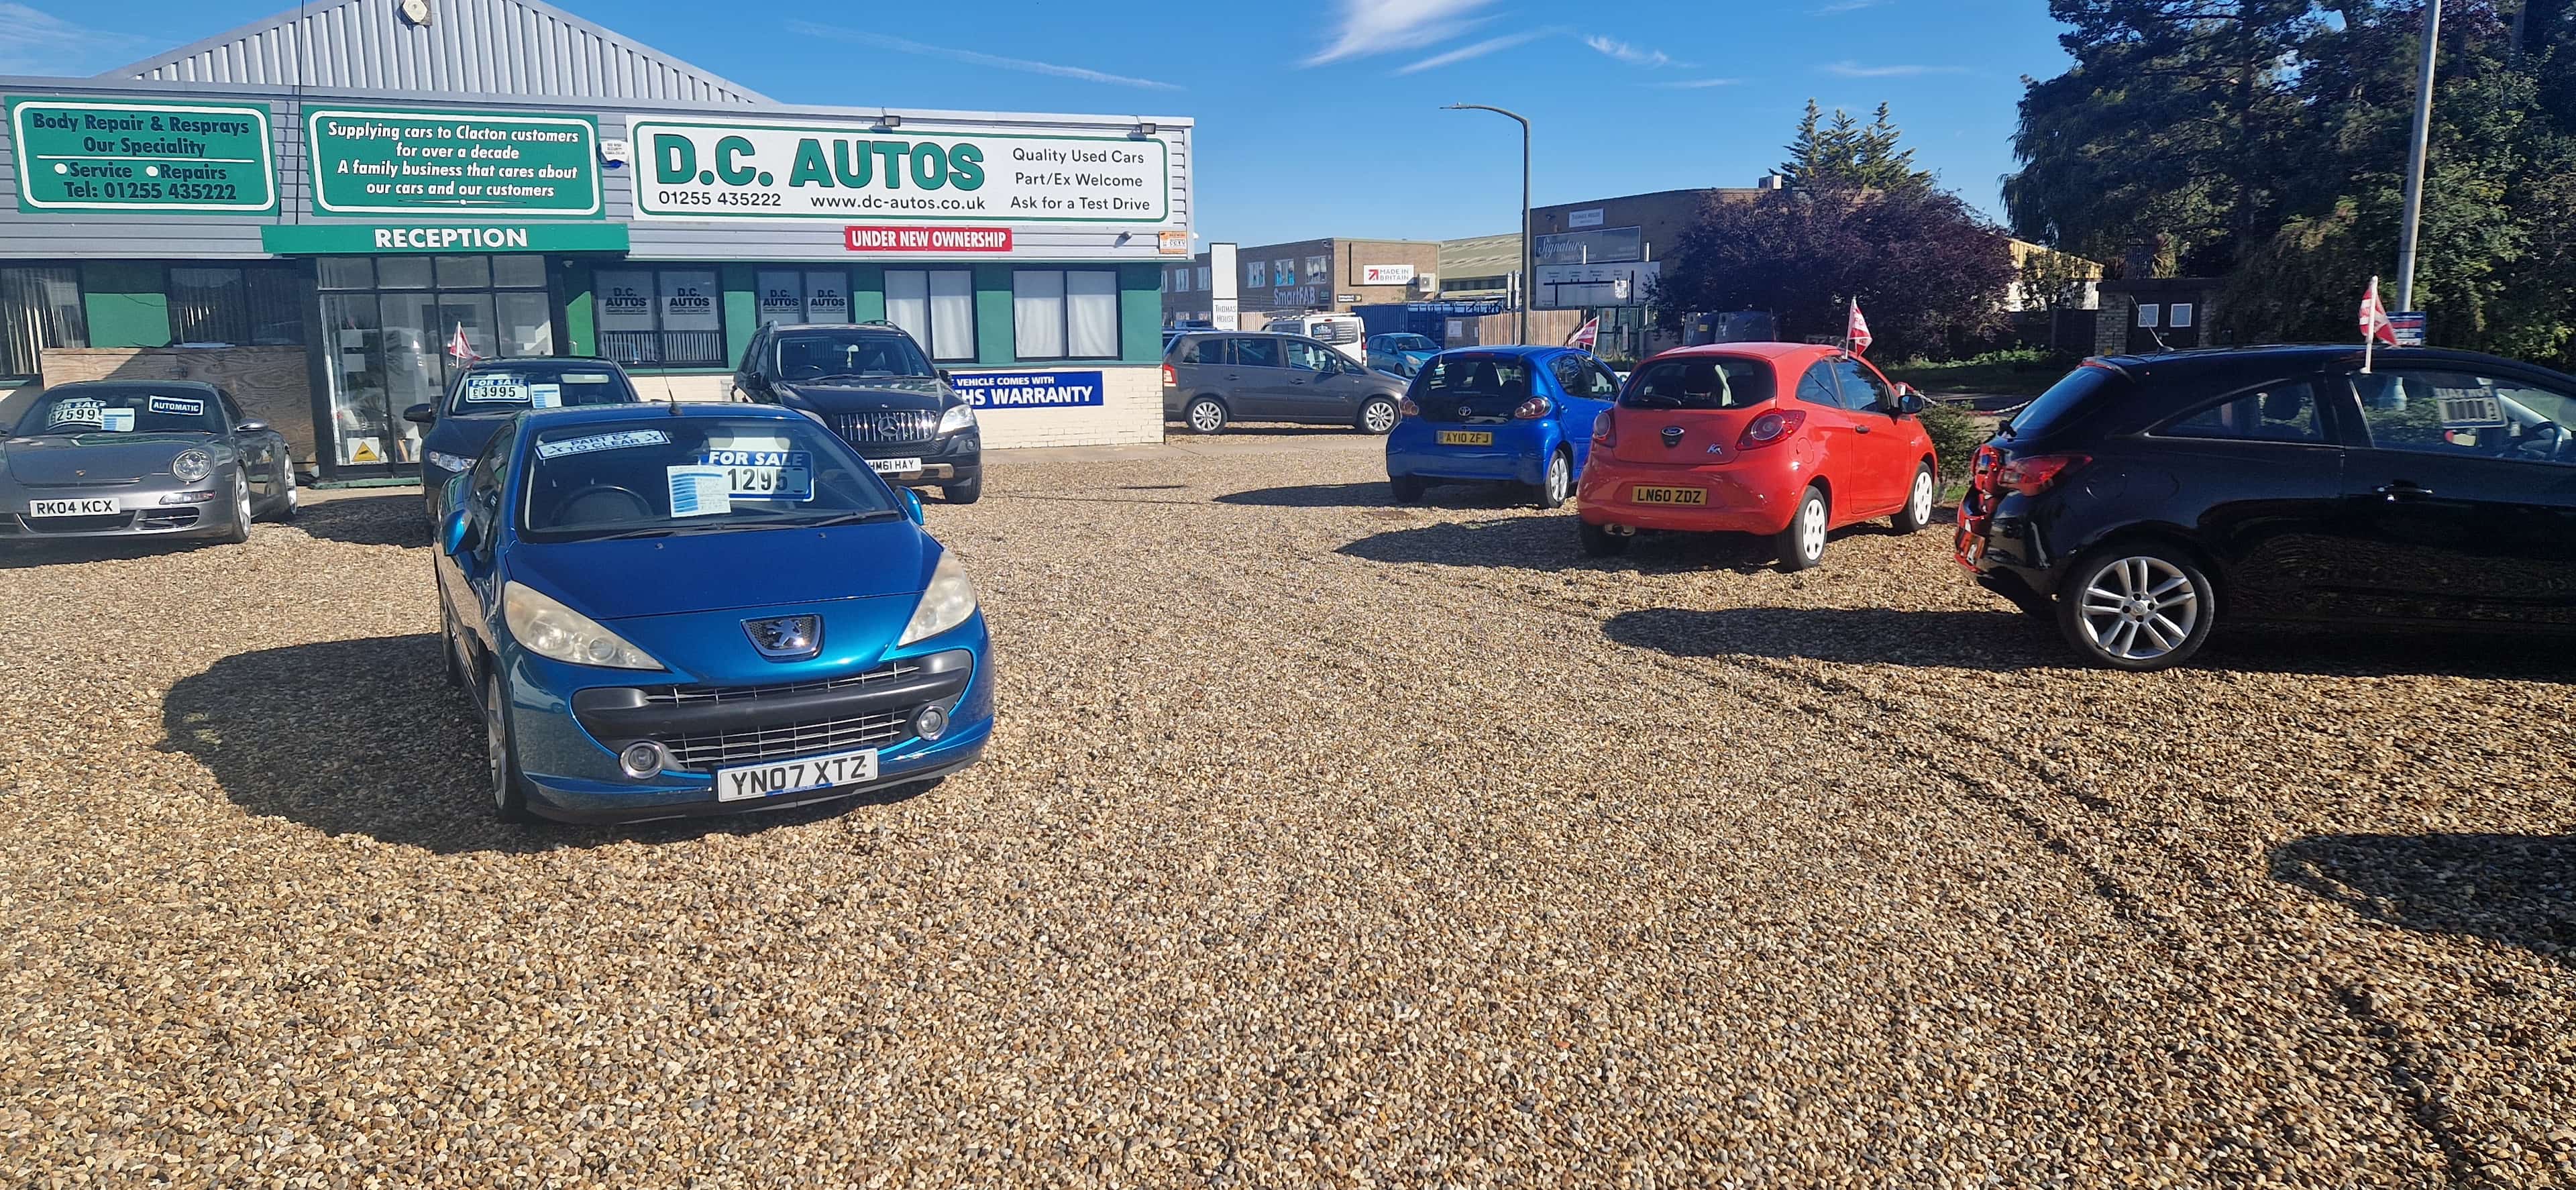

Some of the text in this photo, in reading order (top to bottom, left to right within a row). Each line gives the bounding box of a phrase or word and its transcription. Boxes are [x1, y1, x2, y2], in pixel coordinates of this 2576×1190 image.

[33, 113, 250, 135] Body Repair & Resprays
[328, 122, 579, 143] Supplying cars to Clacton customers
[84, 137, 205, 156] Our Speciality
[396, 142, 519, 159] for over a decade
[653, 133, 985, 191] D.C. AUTOS
[1013, 148, 1144, 165] Quality Used Cars
[70, 162, 226, 181] Service Repairs
[337, 161, 578, 179] A family business that cares about
[1015, 172, 1143, 187] Part/Ex Welcome
[64, 181, 237, 200] Tel: 01255 435222
[366, 181, 554, 197] our cars and our customers
[659, 191, 782, 207] 01255 435222
[810, 195, 985, 210] www.dc-autos.co.uk
[1010, 196, 1150, 211] Ask for a Test Drive
[374, 227, 528, 248] RECEPTION
[851, 230, 1006, 248] UNDER NEW OWNERSHIP
[1538, 236, 1585, 258] Signature
[613, 288, 637, 296] D.C.
[678, 288, 700, 296] D.C.
[770, 289, 790, 297] D.C.
[818, 289, 838, 297] D.C.
[1274, 286, 1316, 306] SmartFAB
[606, 297, 647, 307] AUTOS
[669, 297, 710, 307] AUTOS
[763, 298, 799, 307] AUTOS
[810, 298, 845, 307] AUTOS
[957, 377, 995, 386] VEHICLE
[998, 376, 1030, 385] COMES
[1032, 376, 1055, 384] WITH
[991, 386, 1093, 405] WARRANTY
[153, 402, 199, 412] AUTOMATIC
[572, 437, 607, 445] PART
[592, 438, 639, 448] CLEAR
[1446, 433, 1466, 443] AY10
[708, 451, 804, 466] FOR SALE
[895, 459, 914, 469] HAY
[727, 468, 788, 490] 1295
[1638, 488, 1702, 503] LN60 ZDZ
[37, 500, 113, 515] RK04 KCX
[731, 763, 805, 796] YN07
[814, 755, 866, 784] XTZ
